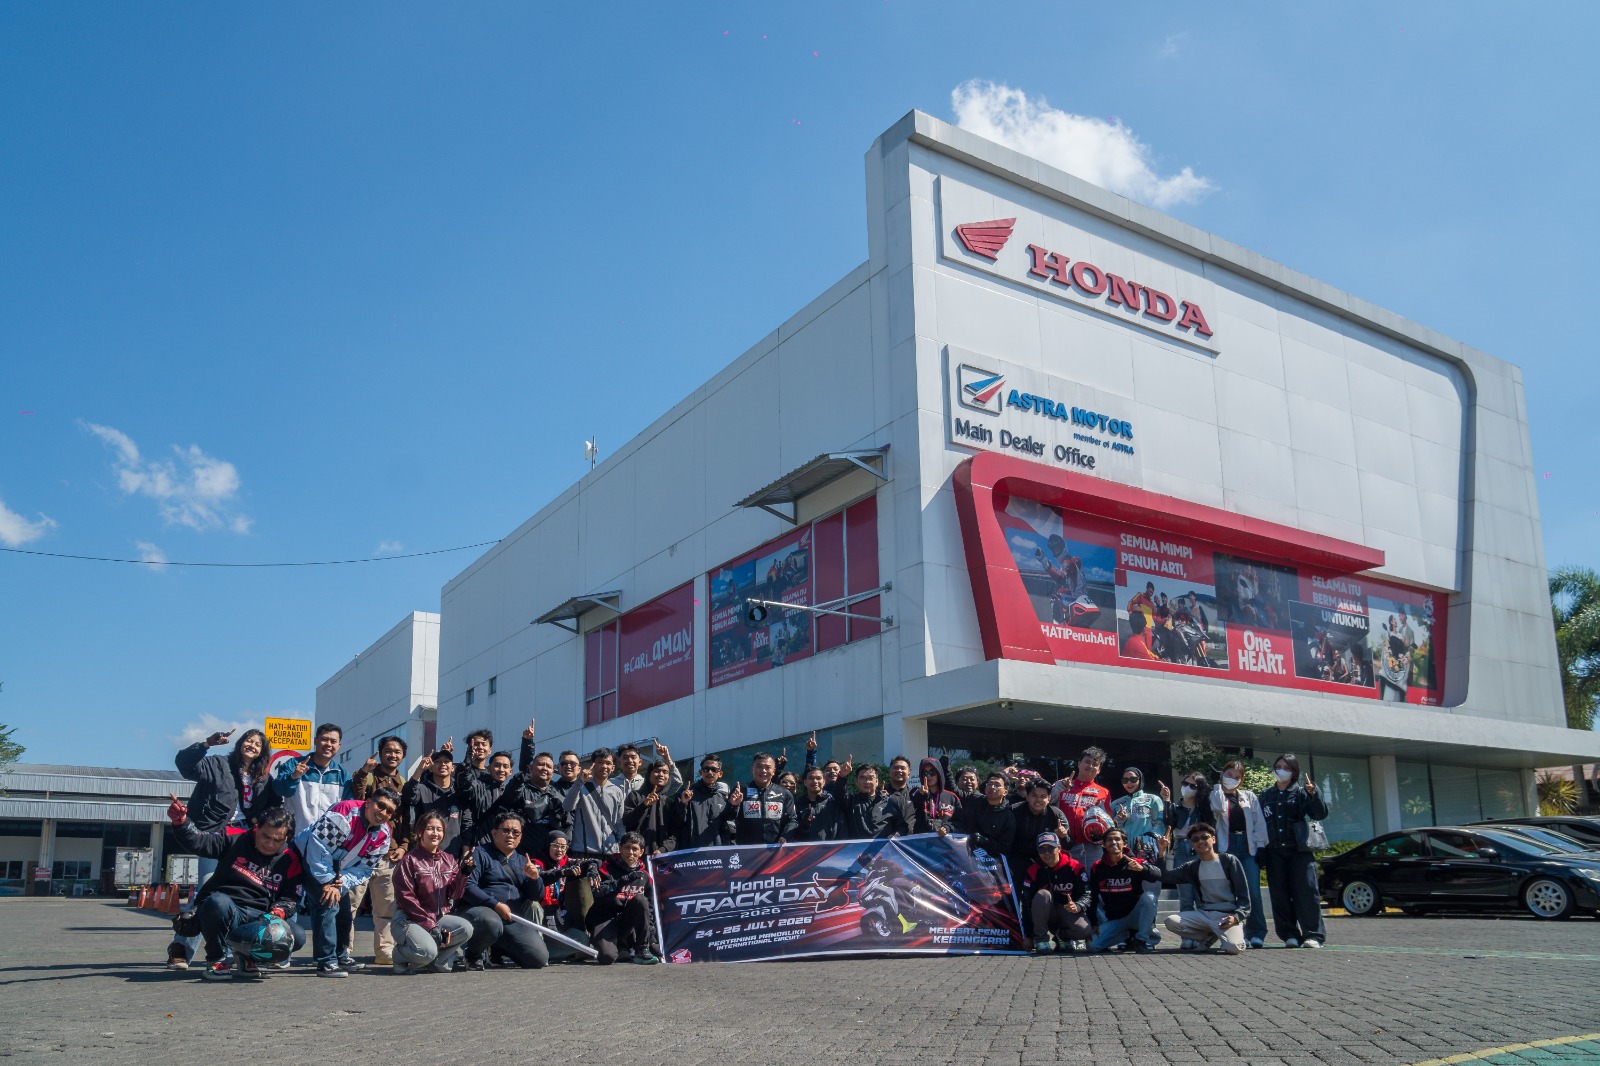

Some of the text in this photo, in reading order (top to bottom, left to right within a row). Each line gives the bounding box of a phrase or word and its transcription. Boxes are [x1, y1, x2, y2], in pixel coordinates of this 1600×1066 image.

[1028, 243, 1213, 336] HONDA
[1008, 389, 1133, 438] ASTRA MOTOR
[955, 418, 1095, 469] Main Dealer Office
[1073, 432, 1101, 446] member
[1111, 441, 1134, 456] ASTRA
[1120, 533, 1192, 560] SEMUA MIMPI
[1121, 552, 1187, 578] PENUH ARTI,
[1312, 575, 1362, 597] SELAMA ITU
[1312, 592, 1363, 613] BERMAKNA
[1321, 610, 1368, 630] UNTUKMU.
[1243, 630, 1271, 653] One
[1238, 649, 1287, 675] HEART.
[268, 722, 308, 732] HATI-HATI!!!
[273, 730, 303, 739] KURANGI
[269, 736, 308, 746] KECEPATAN
[748, 803, 761, 811] XO
[674, 861, 697, 869] ASTRA
[697, 858, 723, 866] MOTOR
[730, 876, 786, 894] Honda
[675, 885, 838, 915] TRACK DAY
[740, 907, 781, 919] 2026
[695, 929, 713, 939] 24
[744, 920, 775, 931] JULY
[778, 916, 812, 926] 2026
[929, 927, 1010, 936] MELESAT PENUH
[708, 929, 806, 947] PERTAMINA MANDALIKA
[716, 938, 773, 950] INTERNATIONAL
[933, 936, 1010, 945] KEBANGGAAN
